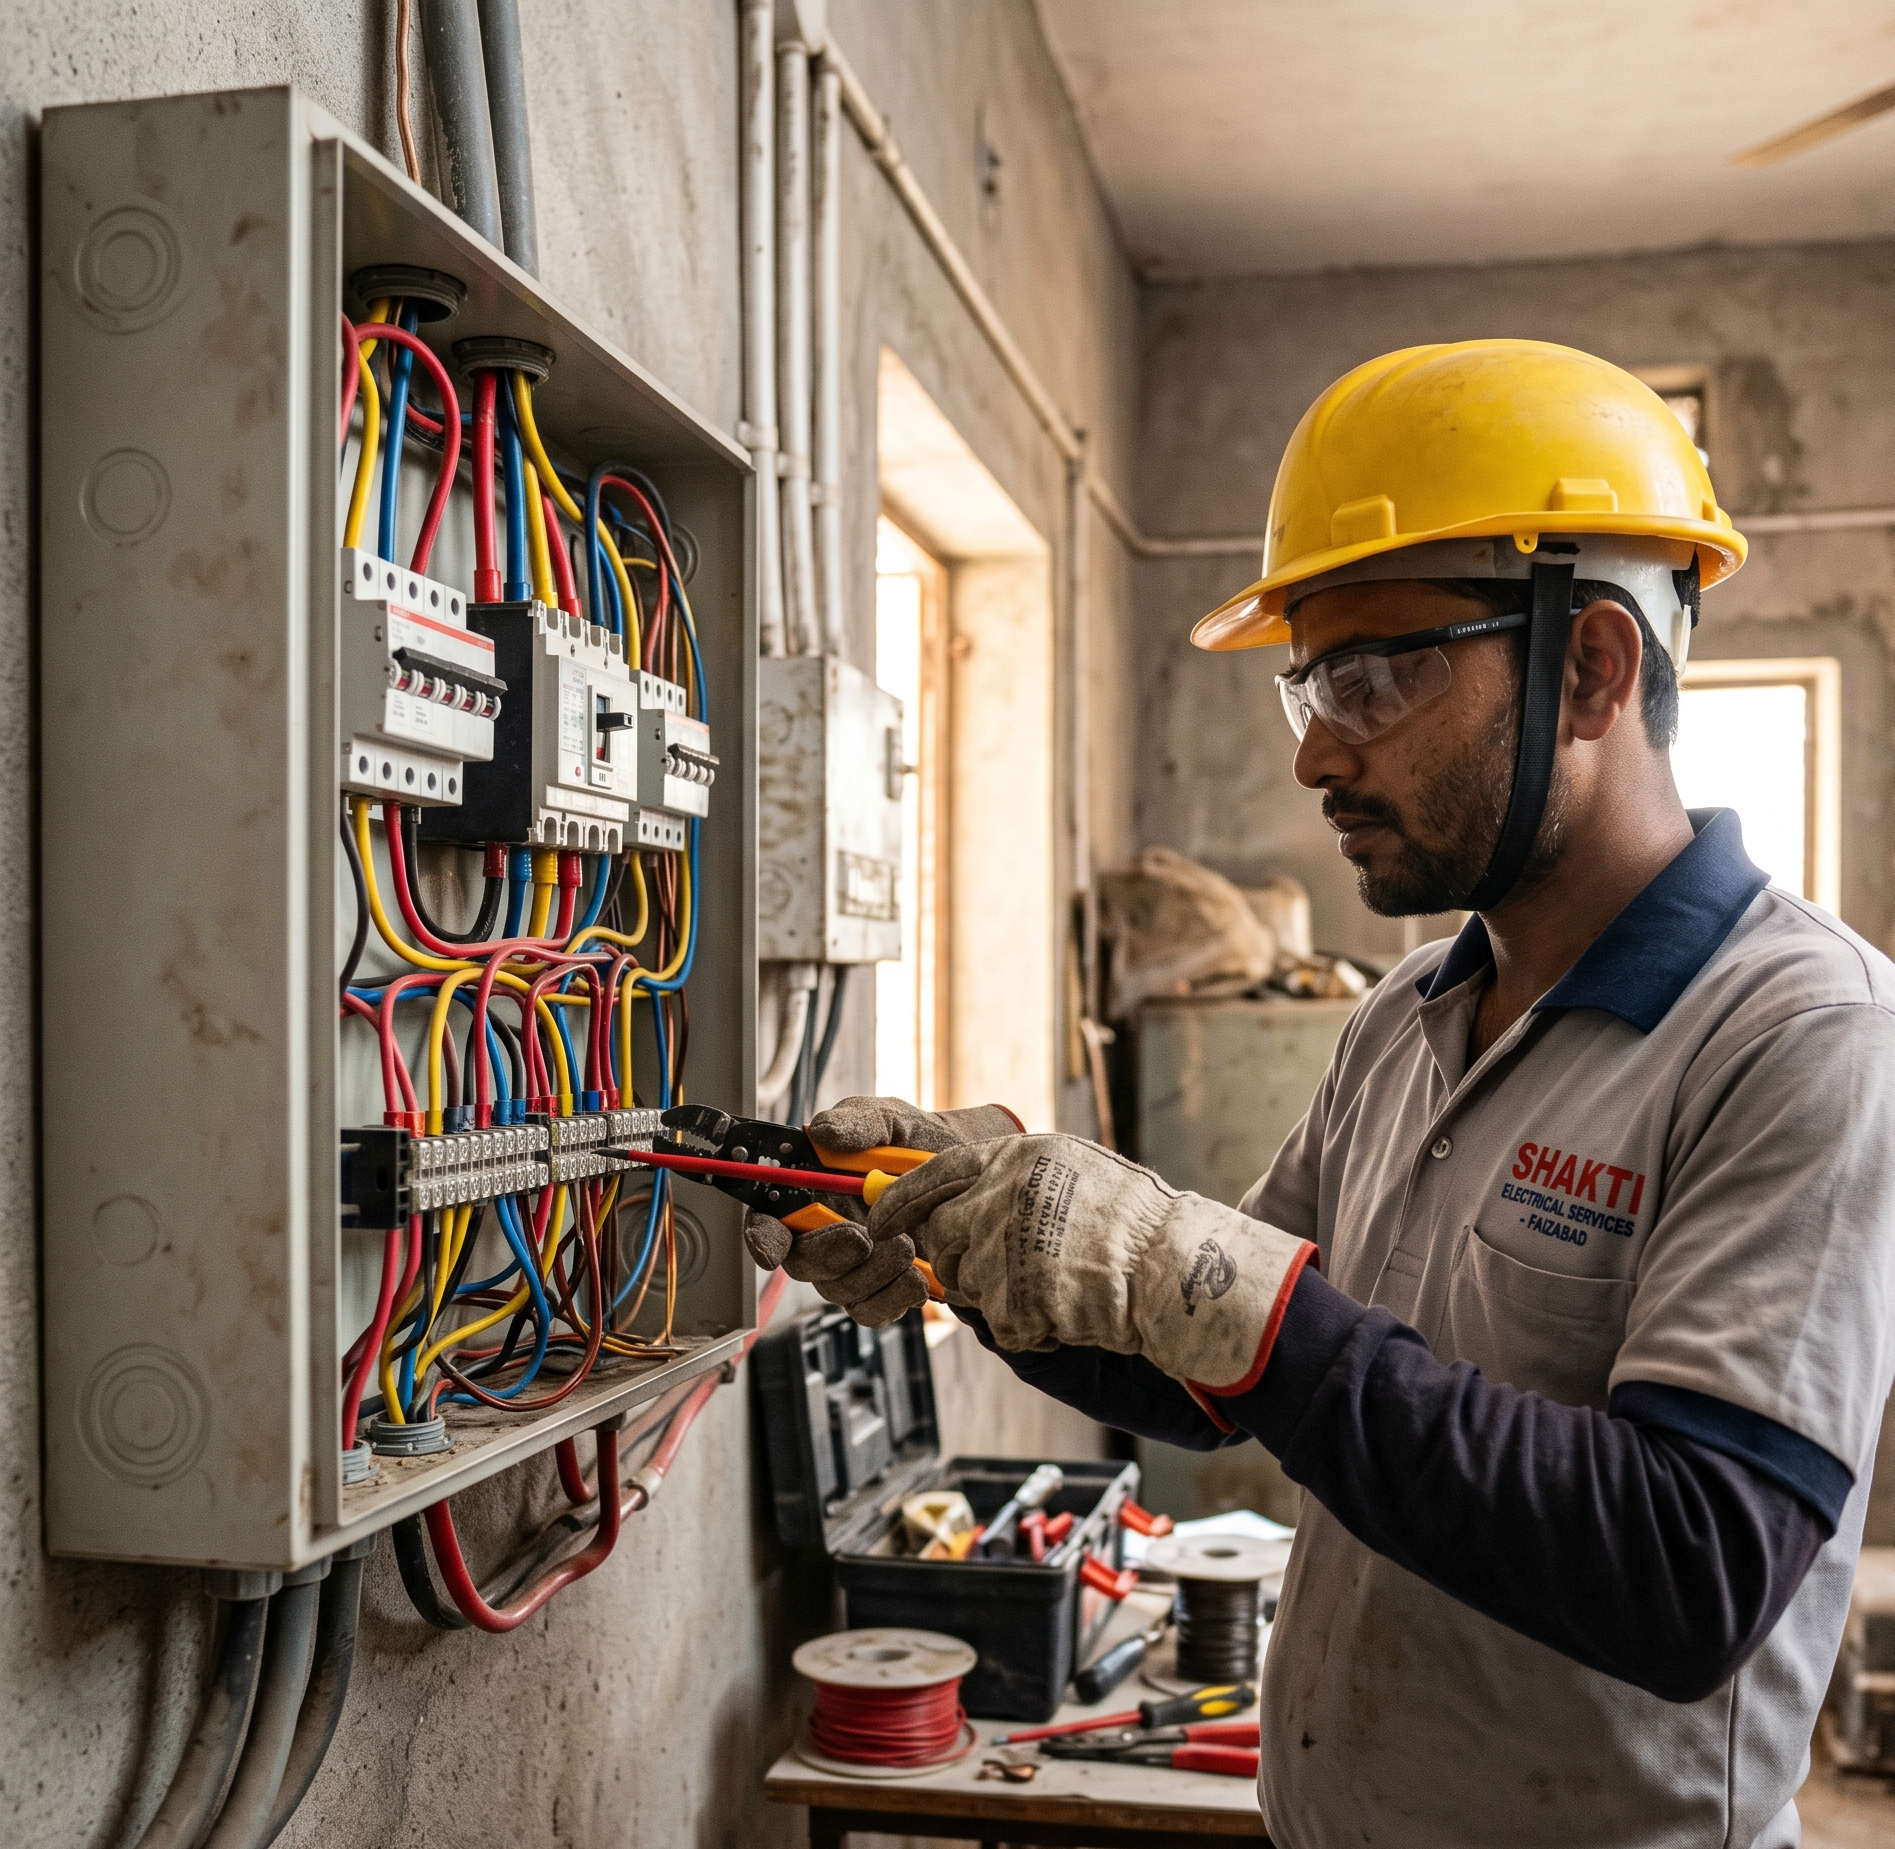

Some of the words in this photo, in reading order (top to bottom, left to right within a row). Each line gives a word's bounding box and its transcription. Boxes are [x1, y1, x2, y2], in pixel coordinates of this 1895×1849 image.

[1512, 1142, 1645, 1215] SHAKTI
[1501, 1183, 1565, 1217] ELECTRICAL
[1567, 1204, 1635, 1237] SERVICES
[1527, 1214, 1588, 1246] FAIZABAD
